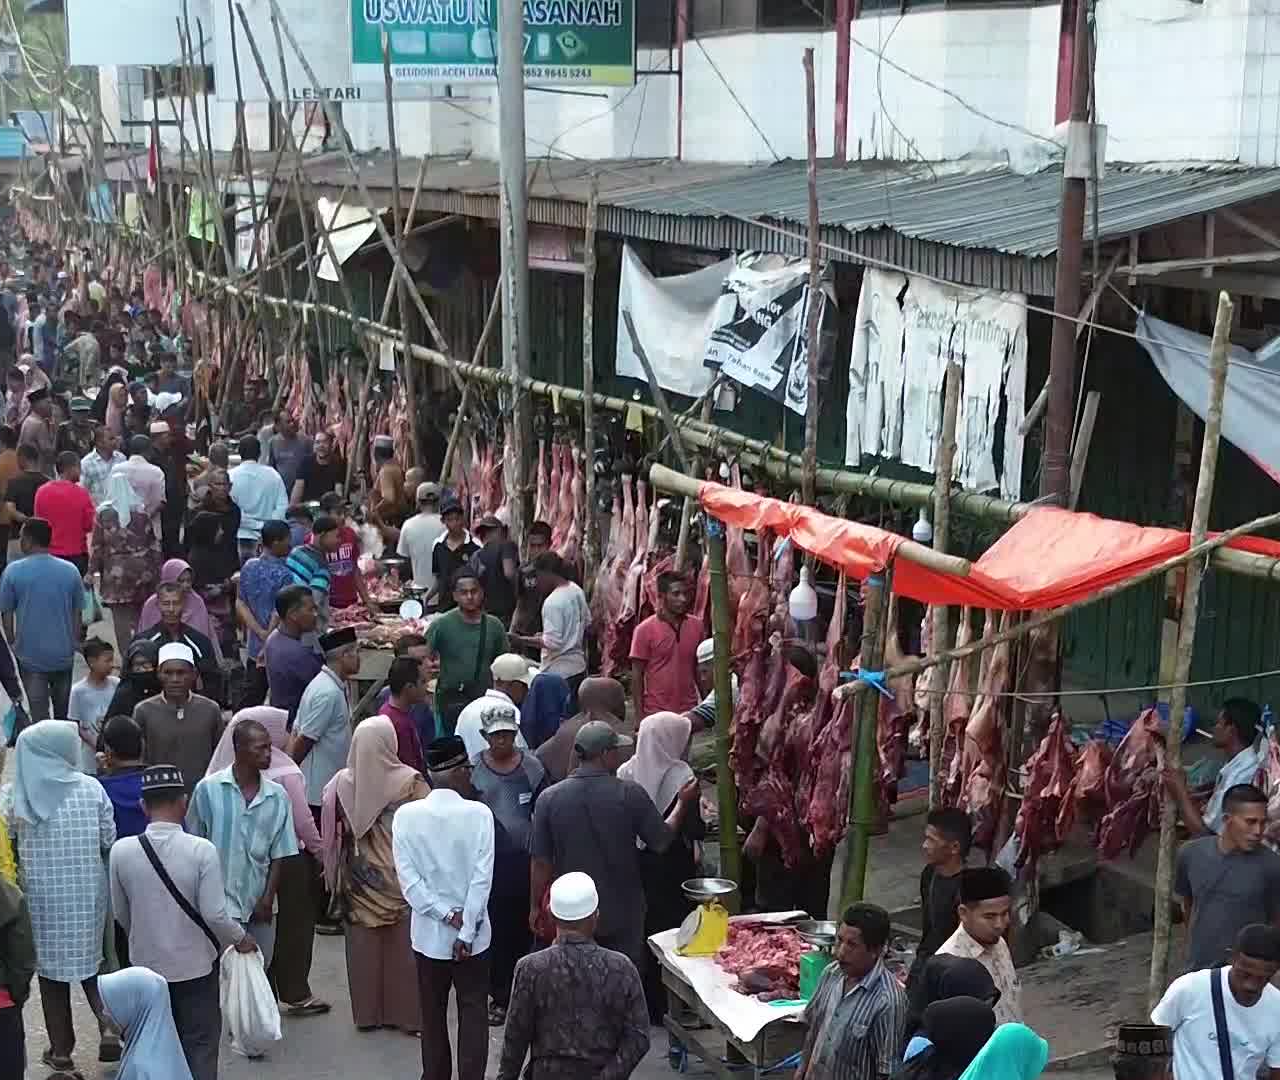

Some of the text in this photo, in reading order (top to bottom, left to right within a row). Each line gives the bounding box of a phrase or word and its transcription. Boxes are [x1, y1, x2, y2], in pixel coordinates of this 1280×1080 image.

[523, 0, 622, 26] ASANAH
[442, 67, 466, 78] ACEH
[468, 67, 497, 78] UTARA
[291, 86, 362, 100] LESTARI
